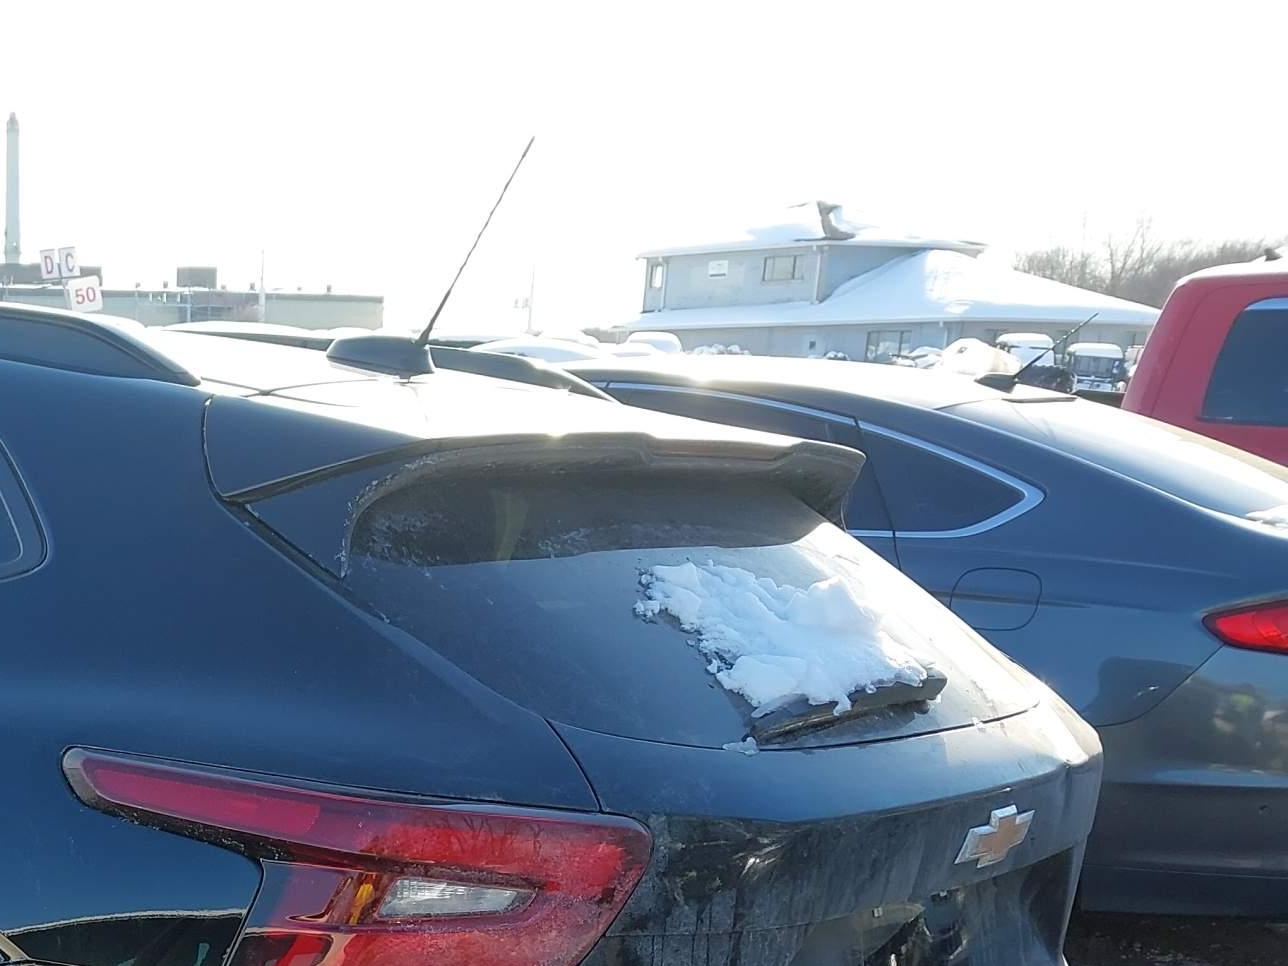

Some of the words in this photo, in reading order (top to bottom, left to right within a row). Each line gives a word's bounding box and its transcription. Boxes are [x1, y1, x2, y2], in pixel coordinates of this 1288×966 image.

[44, 255, 54, 274] D
[65, 253, 75, 272] C
[75, 287, 96, 304] 50
